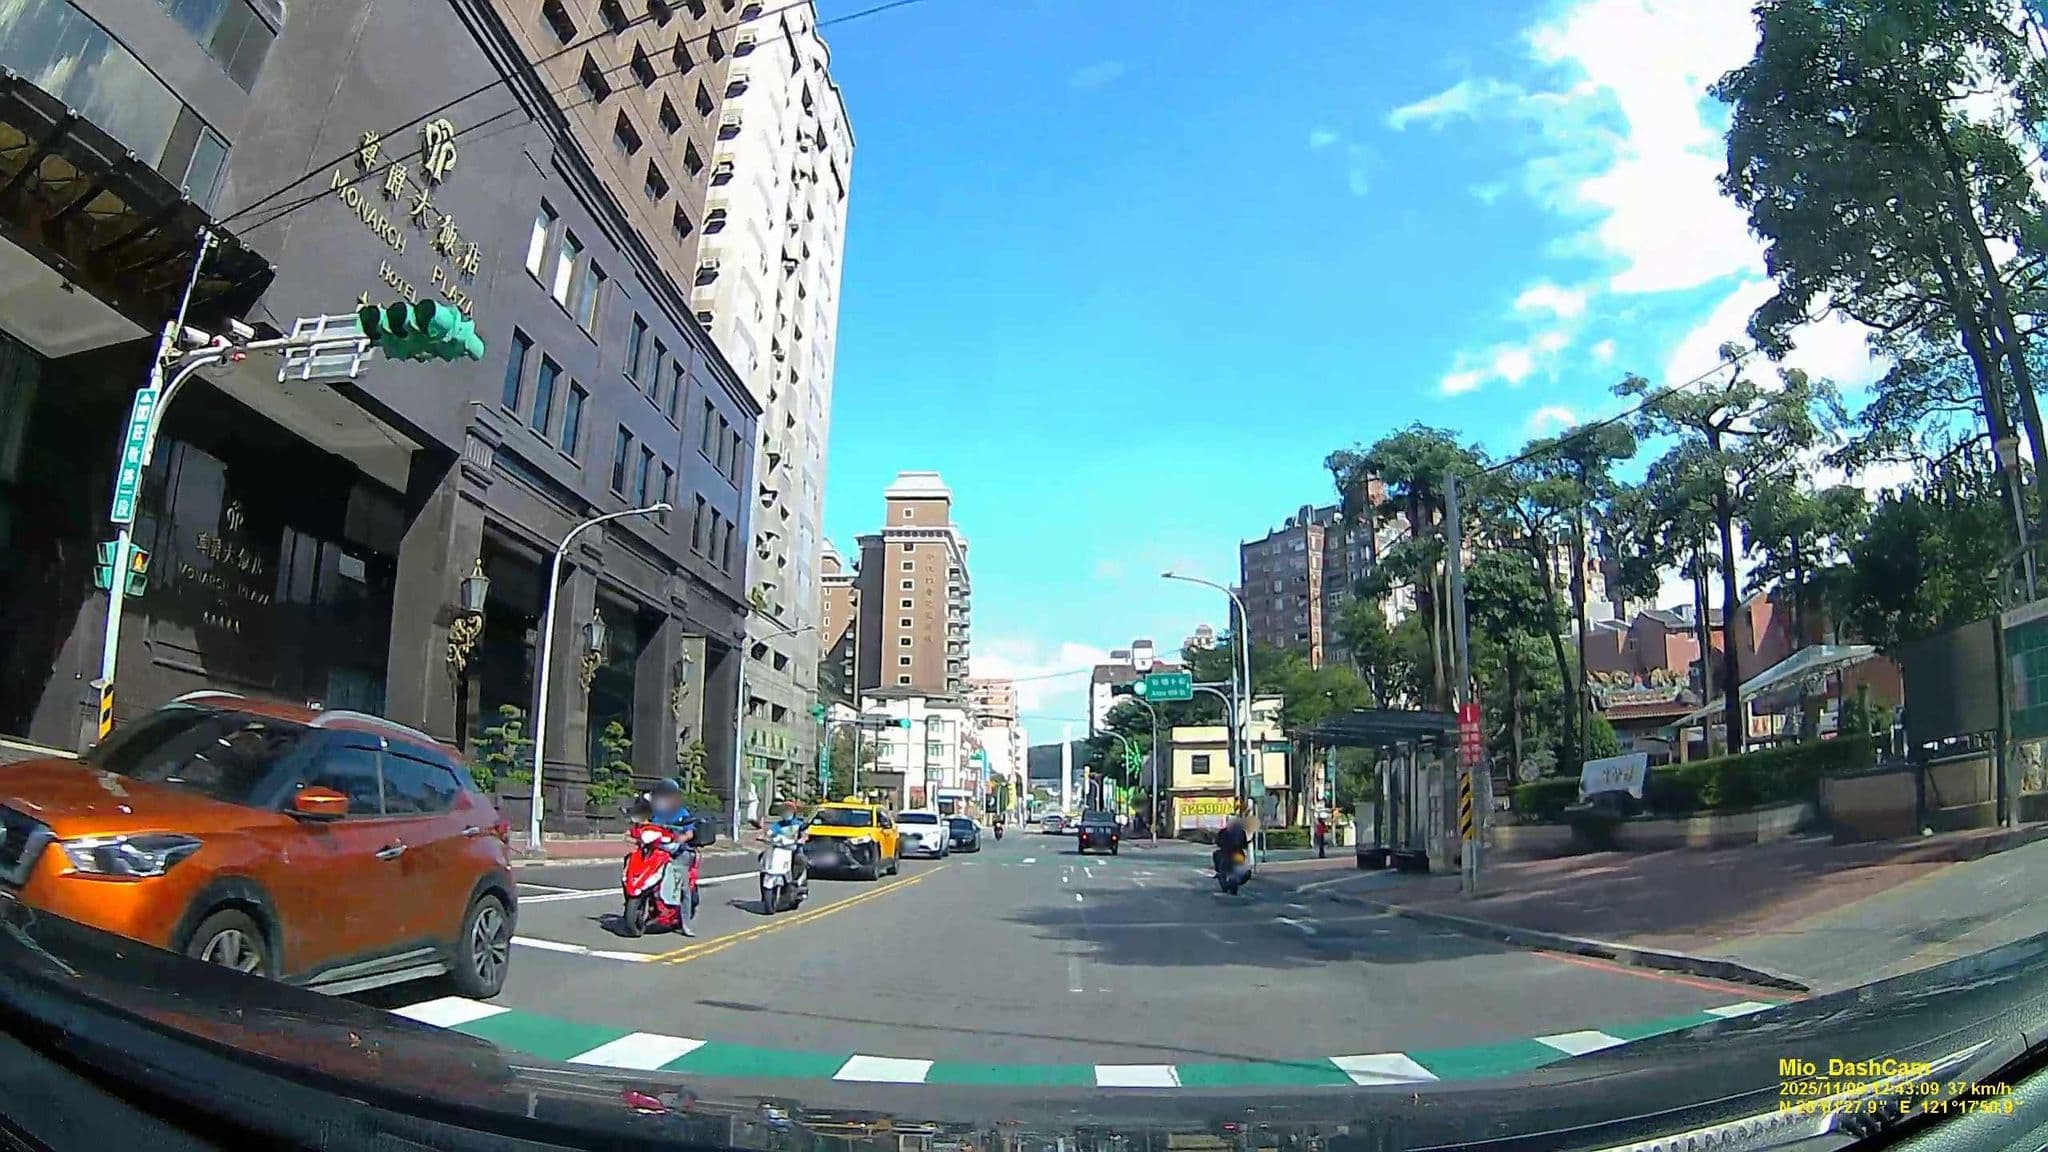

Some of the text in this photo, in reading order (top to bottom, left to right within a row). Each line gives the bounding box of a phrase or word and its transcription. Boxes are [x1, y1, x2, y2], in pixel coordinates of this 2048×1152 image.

[331, 169, 407, 254] MONARCH
[357, 130, 481, 275] 尊爵大飯店
